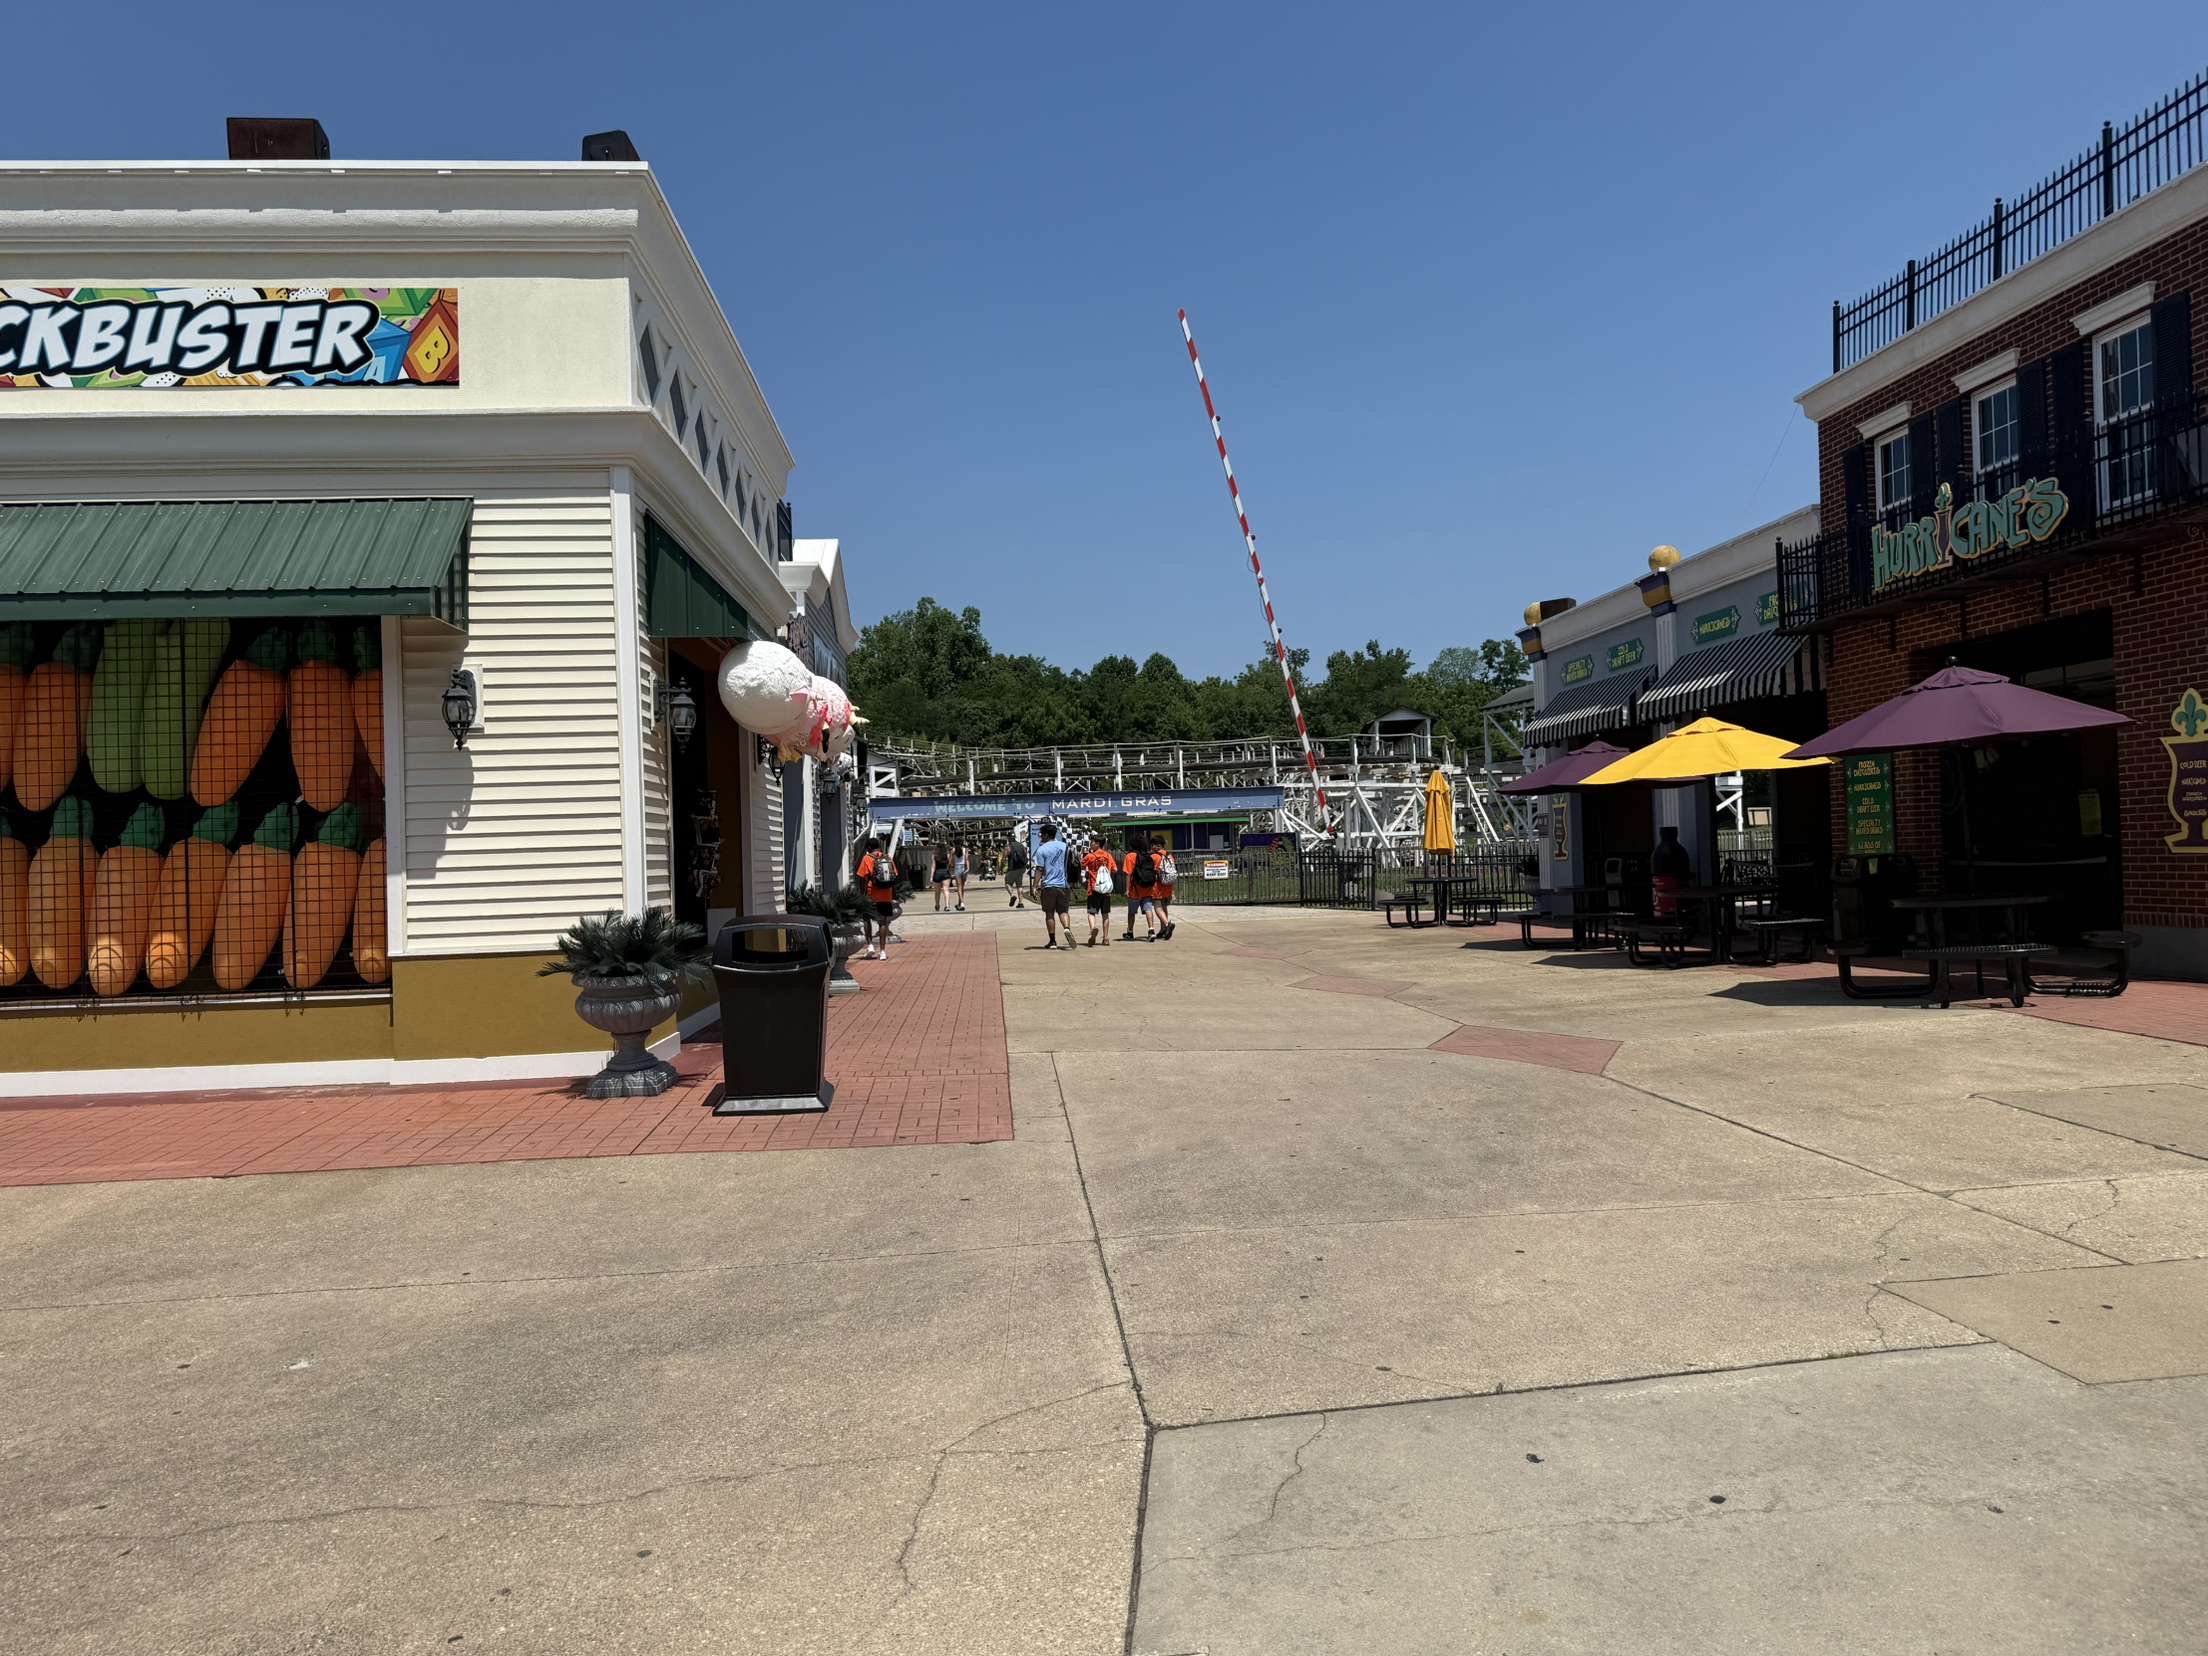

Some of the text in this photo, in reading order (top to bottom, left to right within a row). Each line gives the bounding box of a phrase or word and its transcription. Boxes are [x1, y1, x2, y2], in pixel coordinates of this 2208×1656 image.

[935, 800, 1005, 813] WELCOME
[1052, 797, 1112, 809] MARDI
[1121, 795, 1172, 807] GRAS
